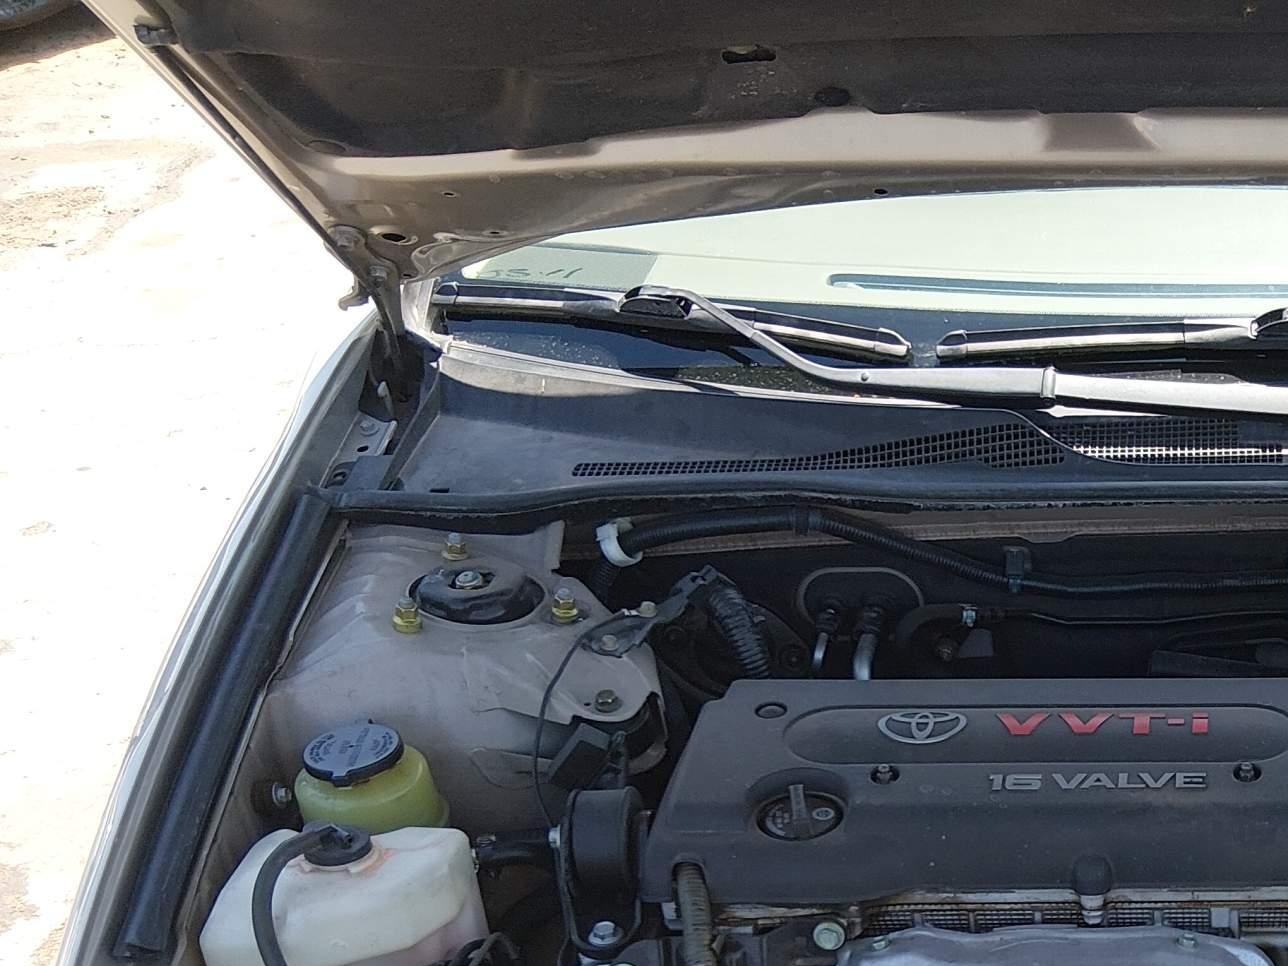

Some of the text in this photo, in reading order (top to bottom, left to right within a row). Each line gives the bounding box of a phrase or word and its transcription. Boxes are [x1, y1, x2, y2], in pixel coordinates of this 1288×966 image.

[996, 712, 1209, 735] VVT-i
[989, 772, 1206, 791] 16 VALVE
